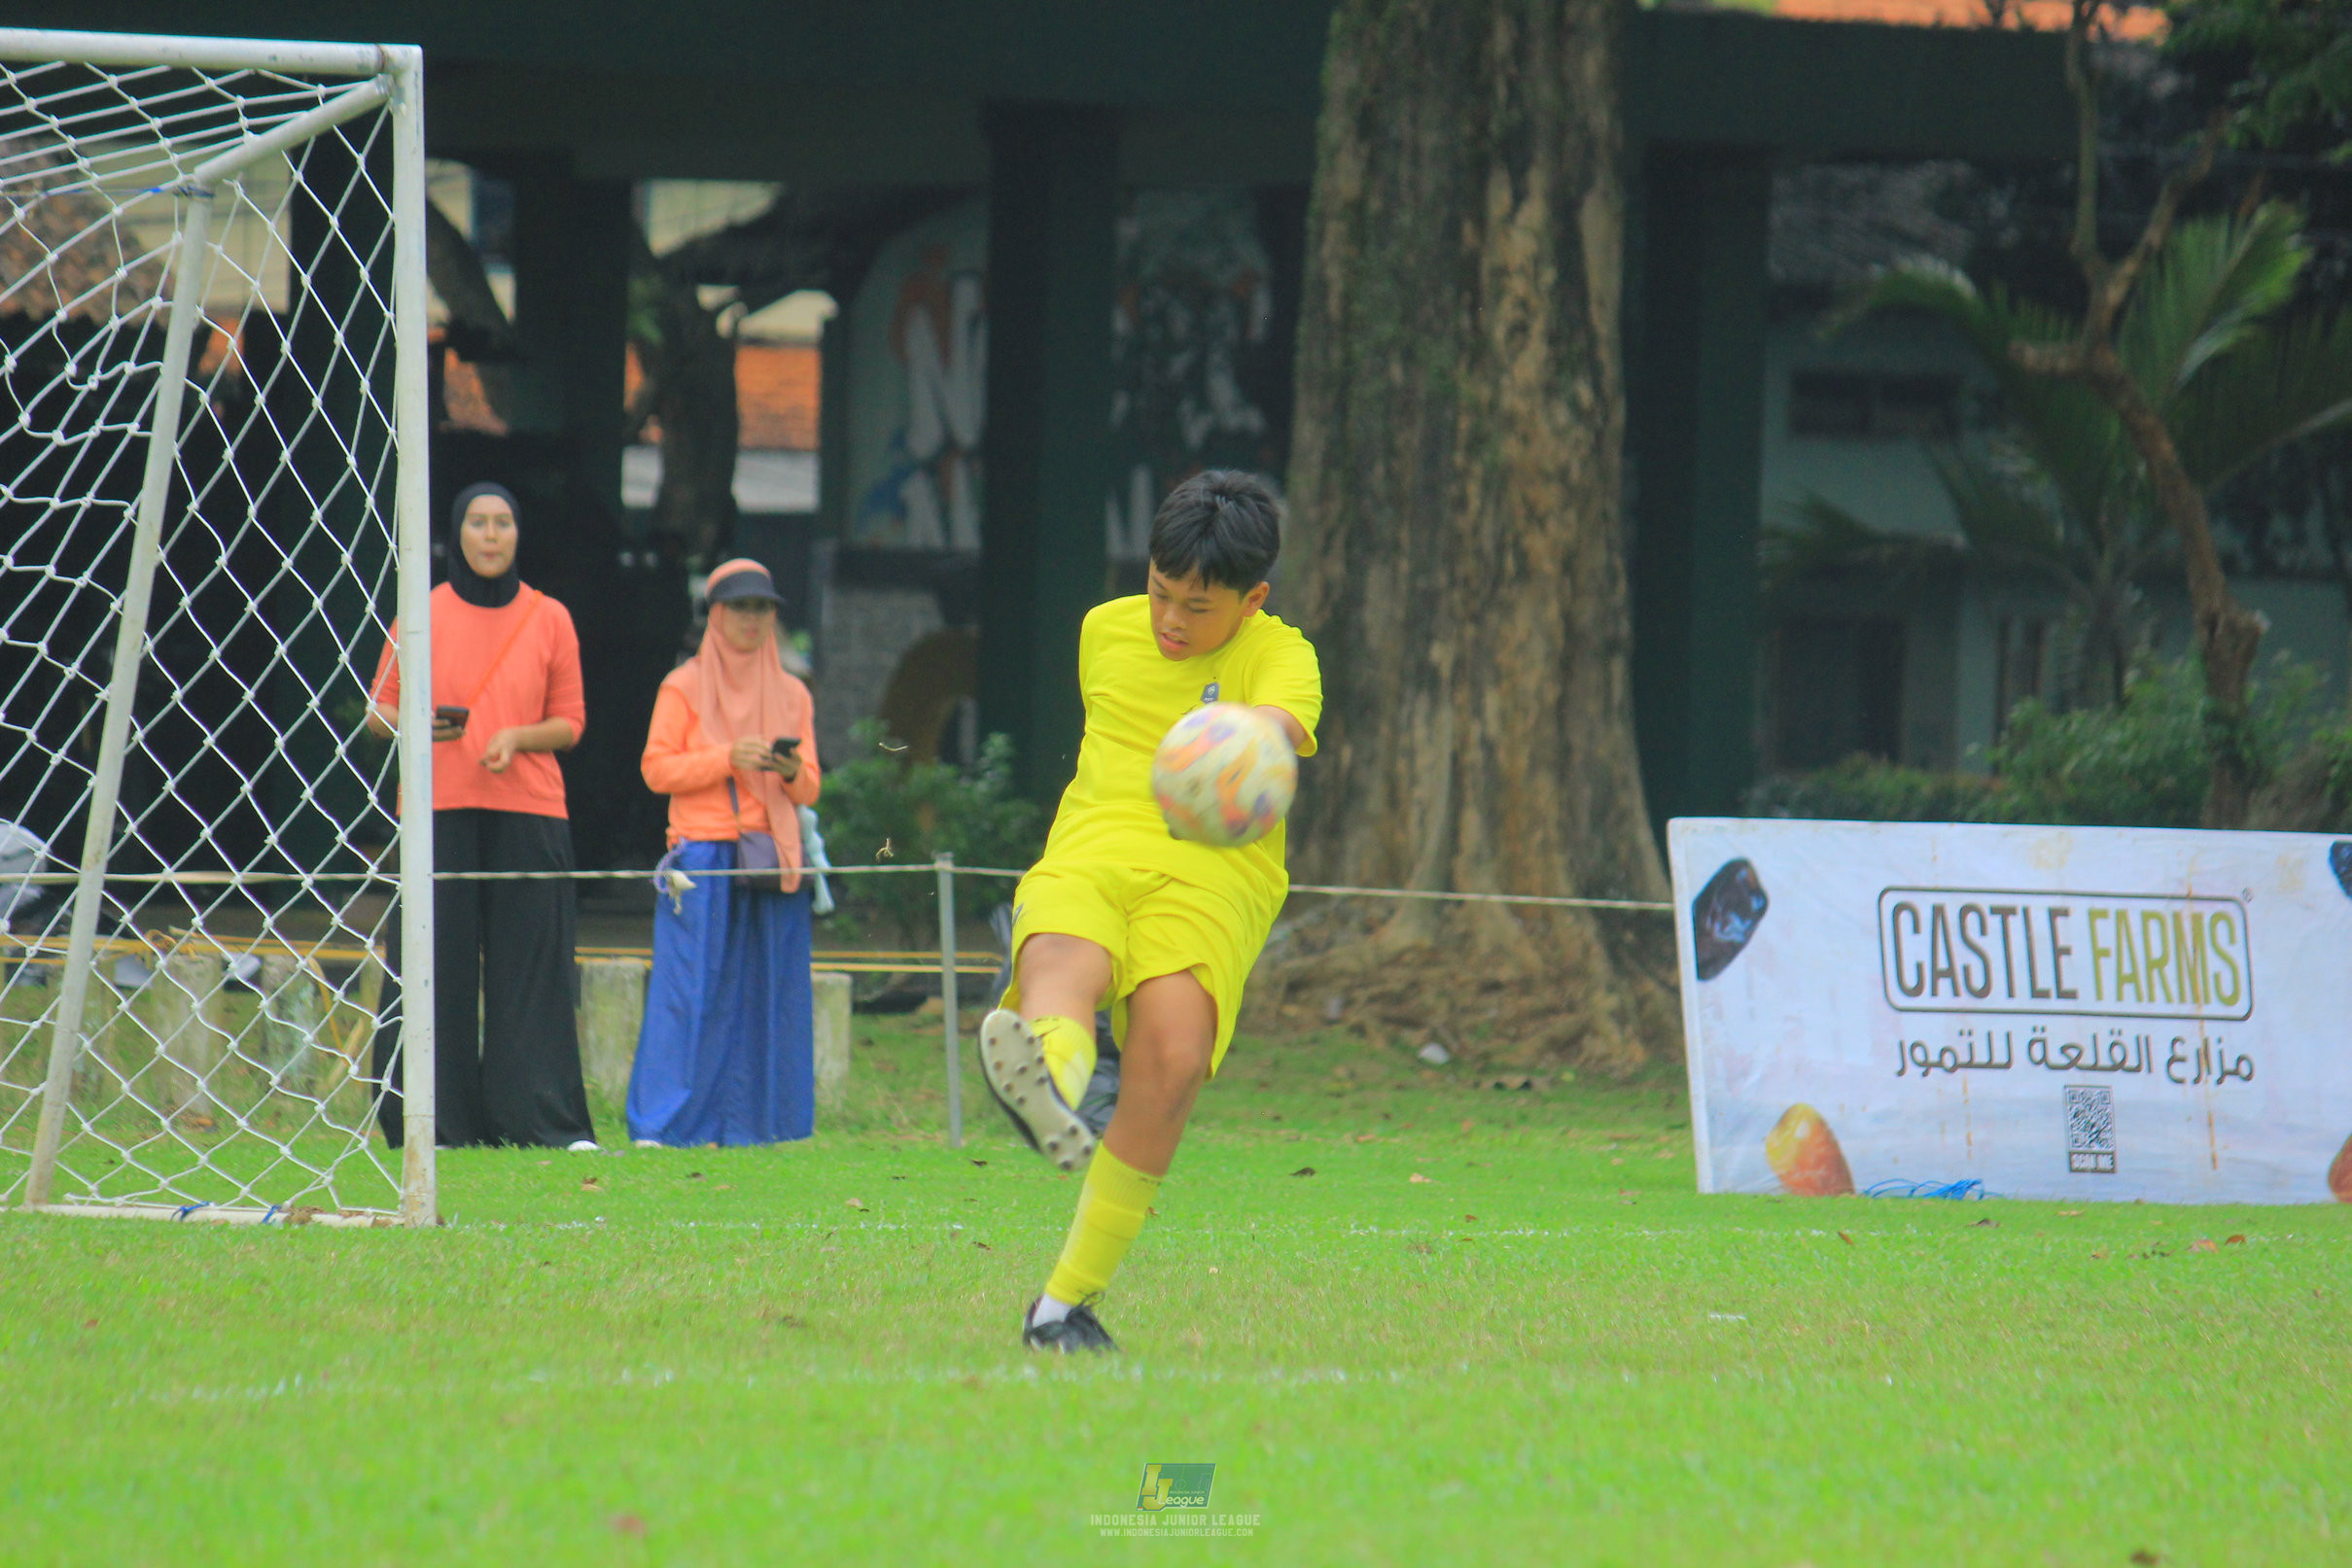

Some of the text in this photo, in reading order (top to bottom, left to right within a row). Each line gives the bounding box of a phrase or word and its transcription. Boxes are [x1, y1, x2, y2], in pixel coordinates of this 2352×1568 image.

[1893, 901, 2241, 1006] CASTLE FARMS
[1896, 1025, 2255, 1085] مزارع القلعة للتمور
